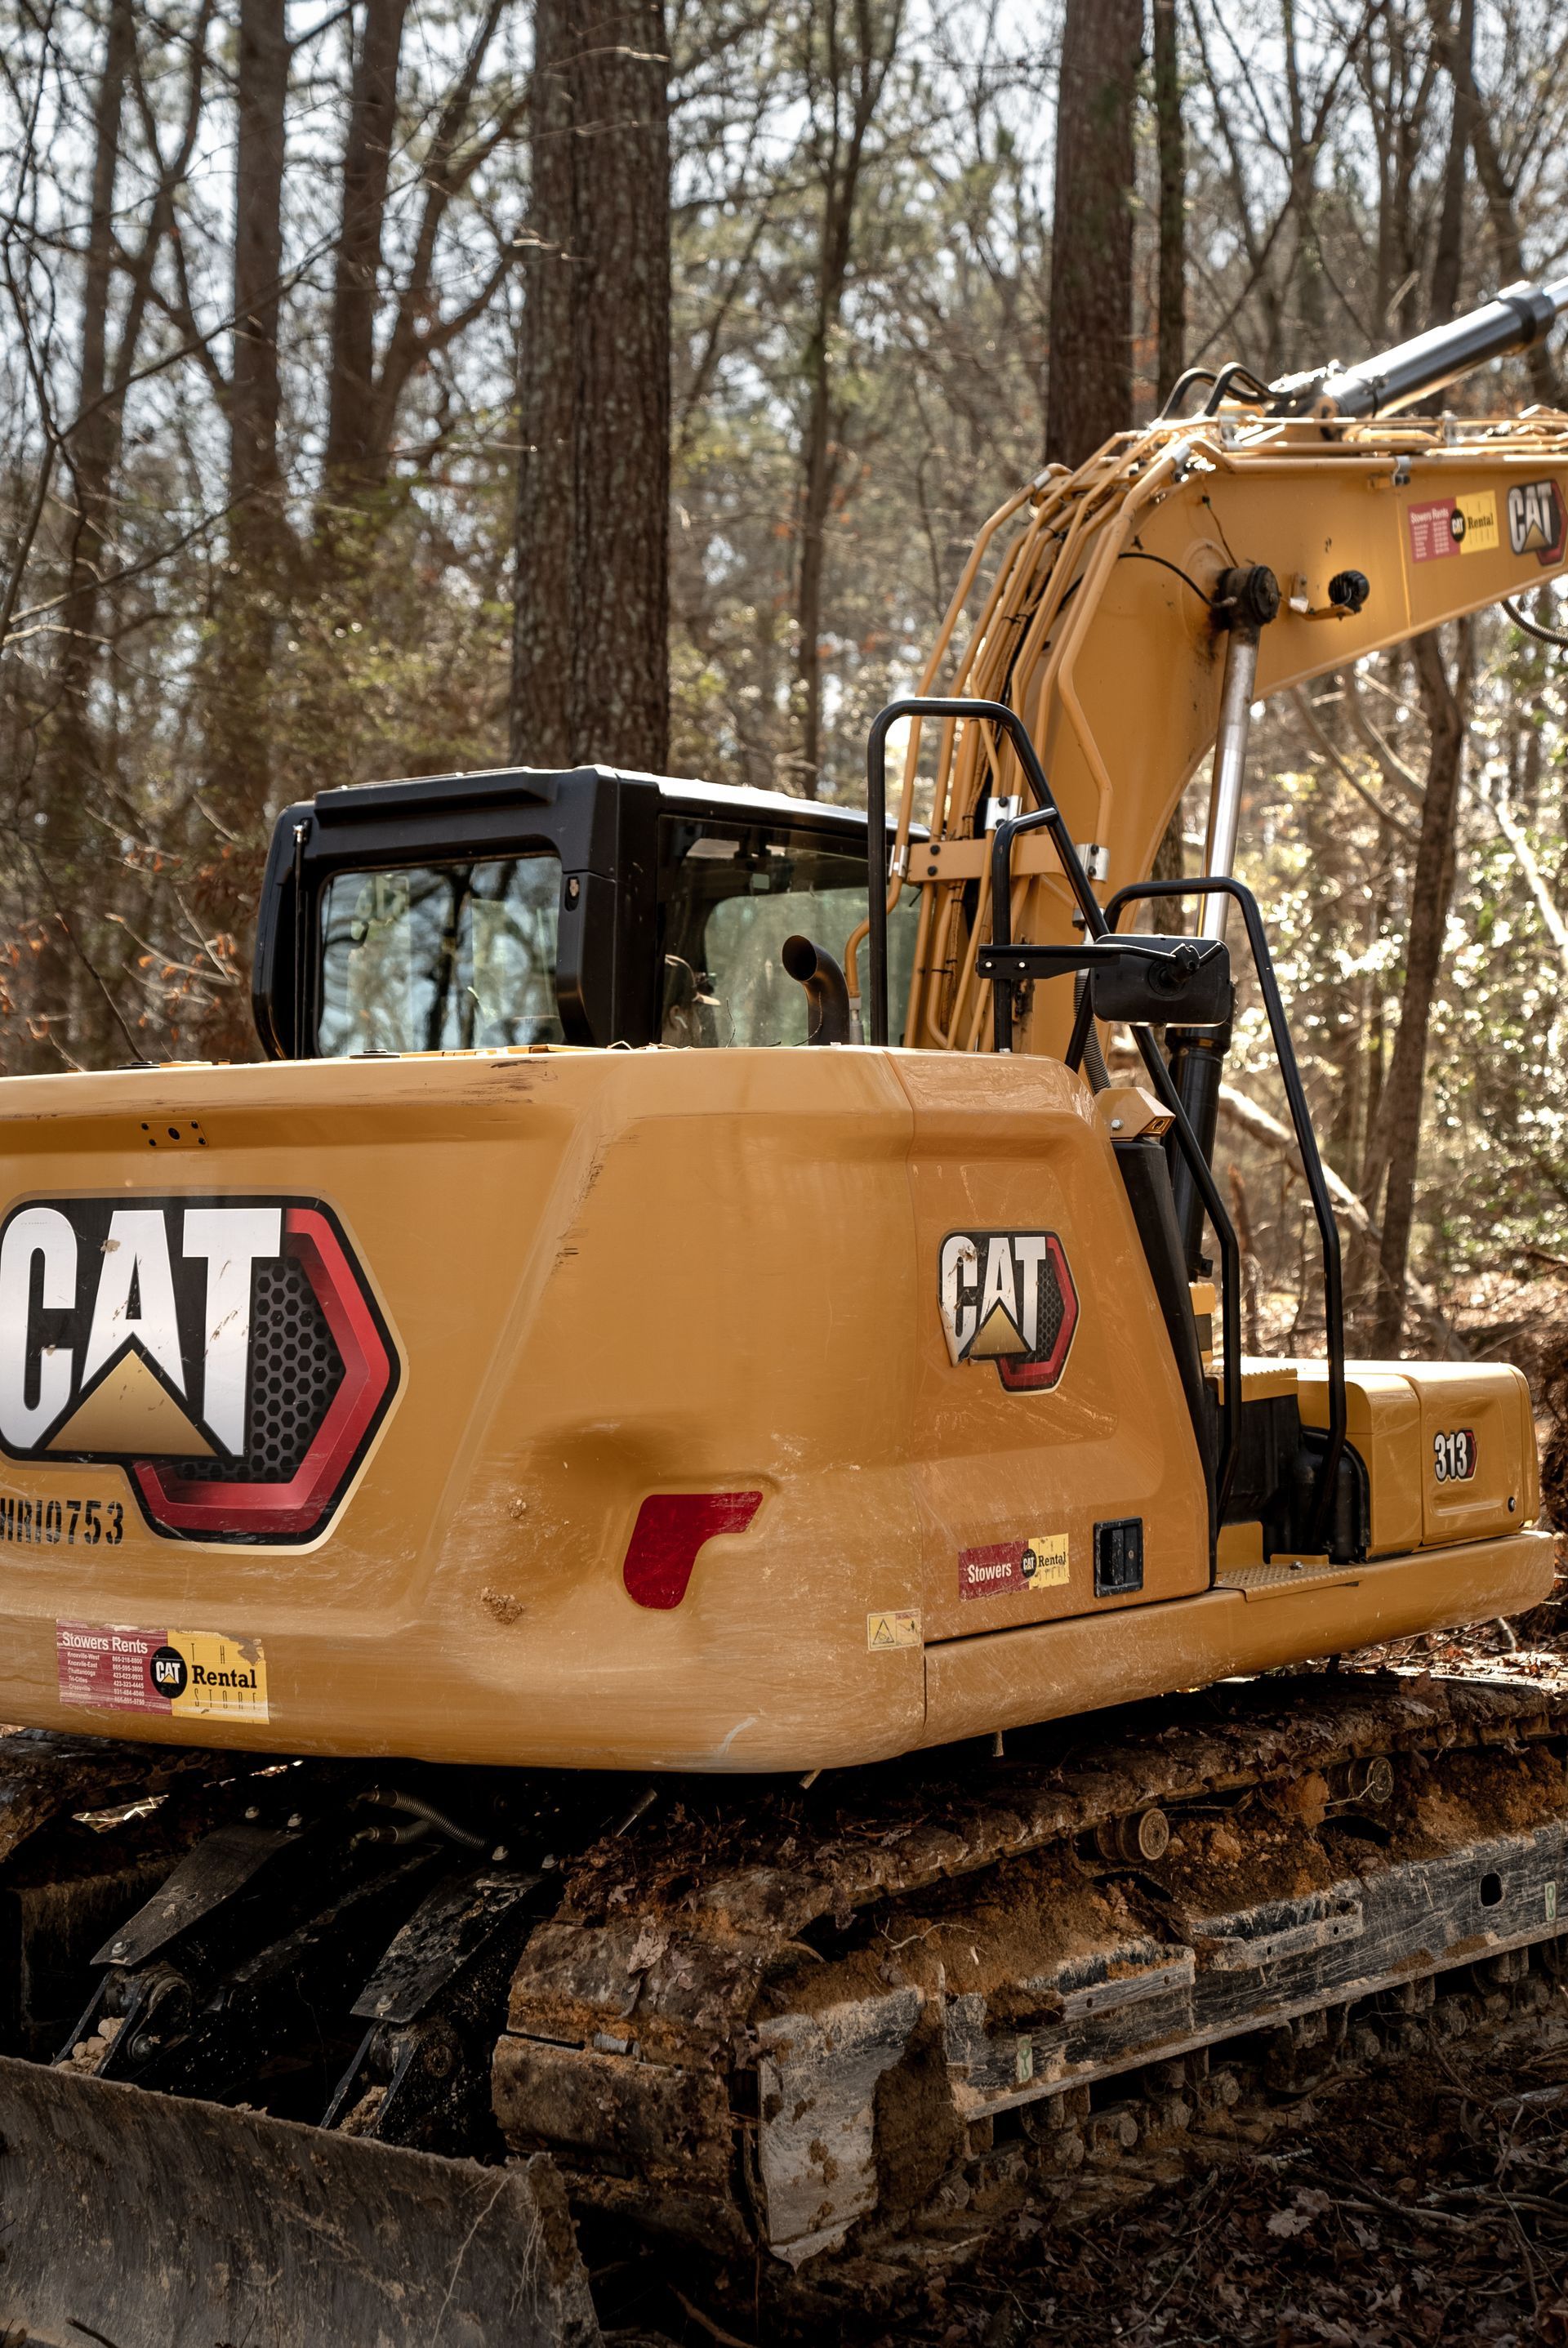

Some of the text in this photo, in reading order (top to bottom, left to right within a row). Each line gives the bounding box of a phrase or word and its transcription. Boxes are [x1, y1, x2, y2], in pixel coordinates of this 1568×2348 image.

[1451, 517, 1463, 534] CAT
[1467, 513, 1494, 529] Rental
[1508, 482, 1552, 553] CAT
[942, 1236, 1046, 1361] CAT
[0, 1207, 282, 1457] CAT
[1434, 1432, 1468, 1479] 313
[1022, 1557, 1035, 1571] CAT
[1038, 1551, 1067, 1567] Rental
[967, 1563, 1012, 1584] Stowers
[61, 1631, 149, 1654] Stowers Rents
[155, 1661, 180, 1684] CAT
[191, 1664, 257, 1689] Rental
